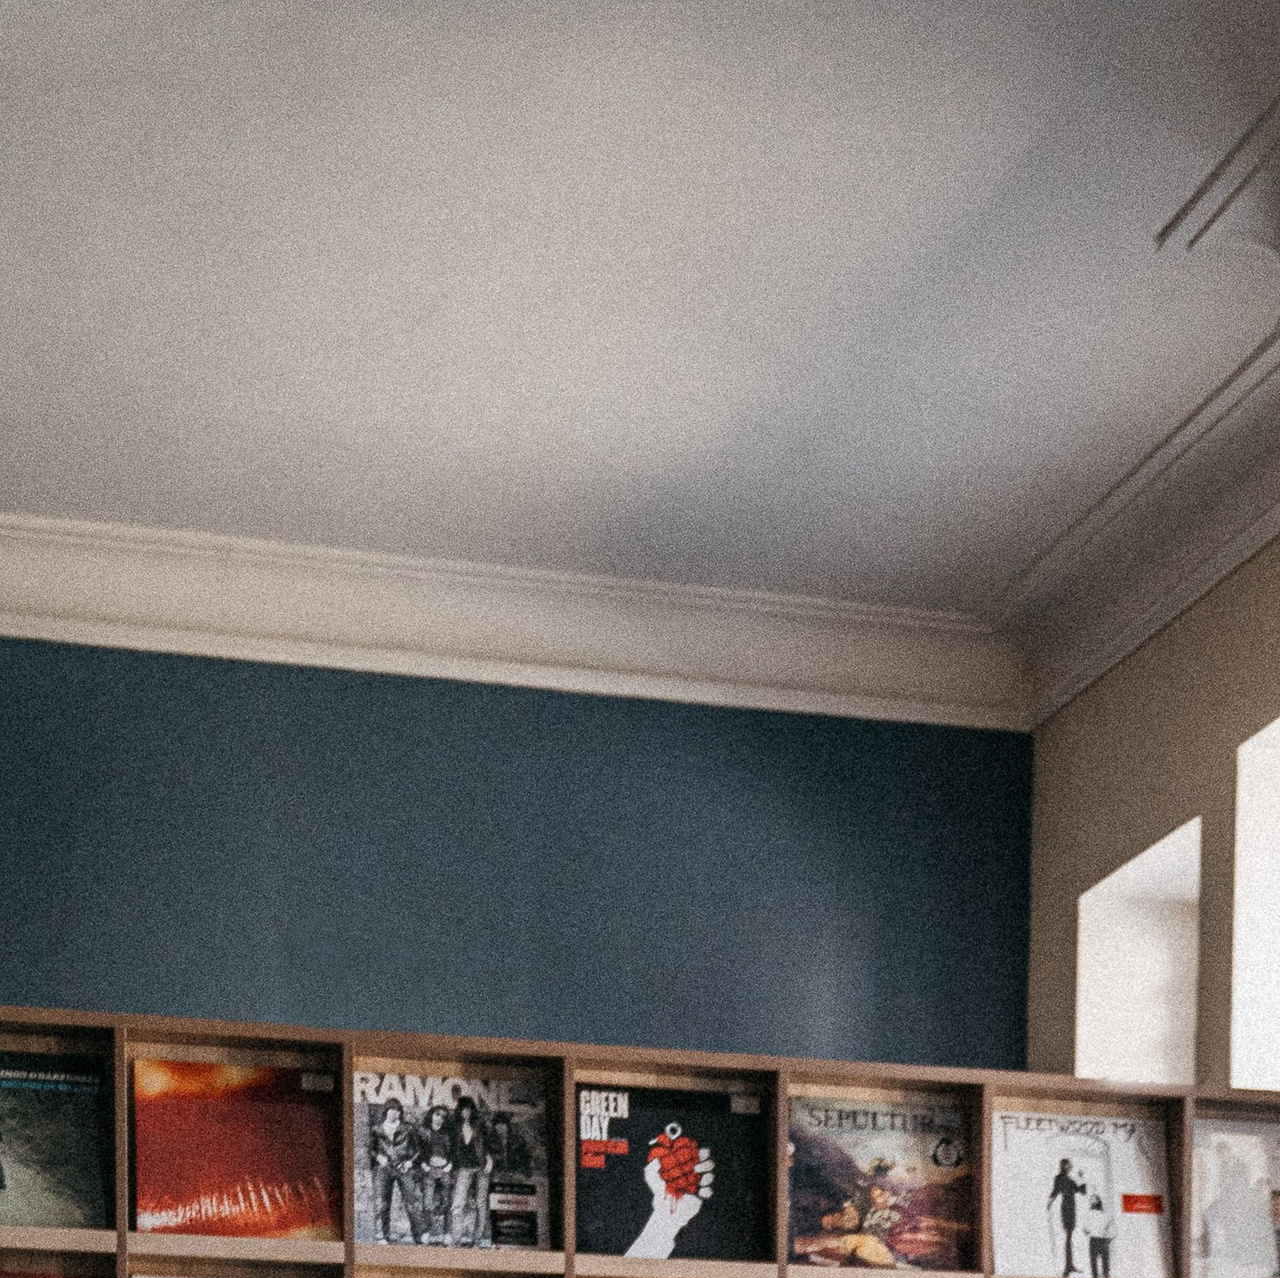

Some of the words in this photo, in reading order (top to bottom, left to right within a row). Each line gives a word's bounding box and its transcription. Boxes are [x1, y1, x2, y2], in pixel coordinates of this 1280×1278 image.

[579, 1088, 630, 1118] GREEN
[579, 1114, 610, 1140] DAY
[808, 1106, 952, 1134] SEPULTUR
